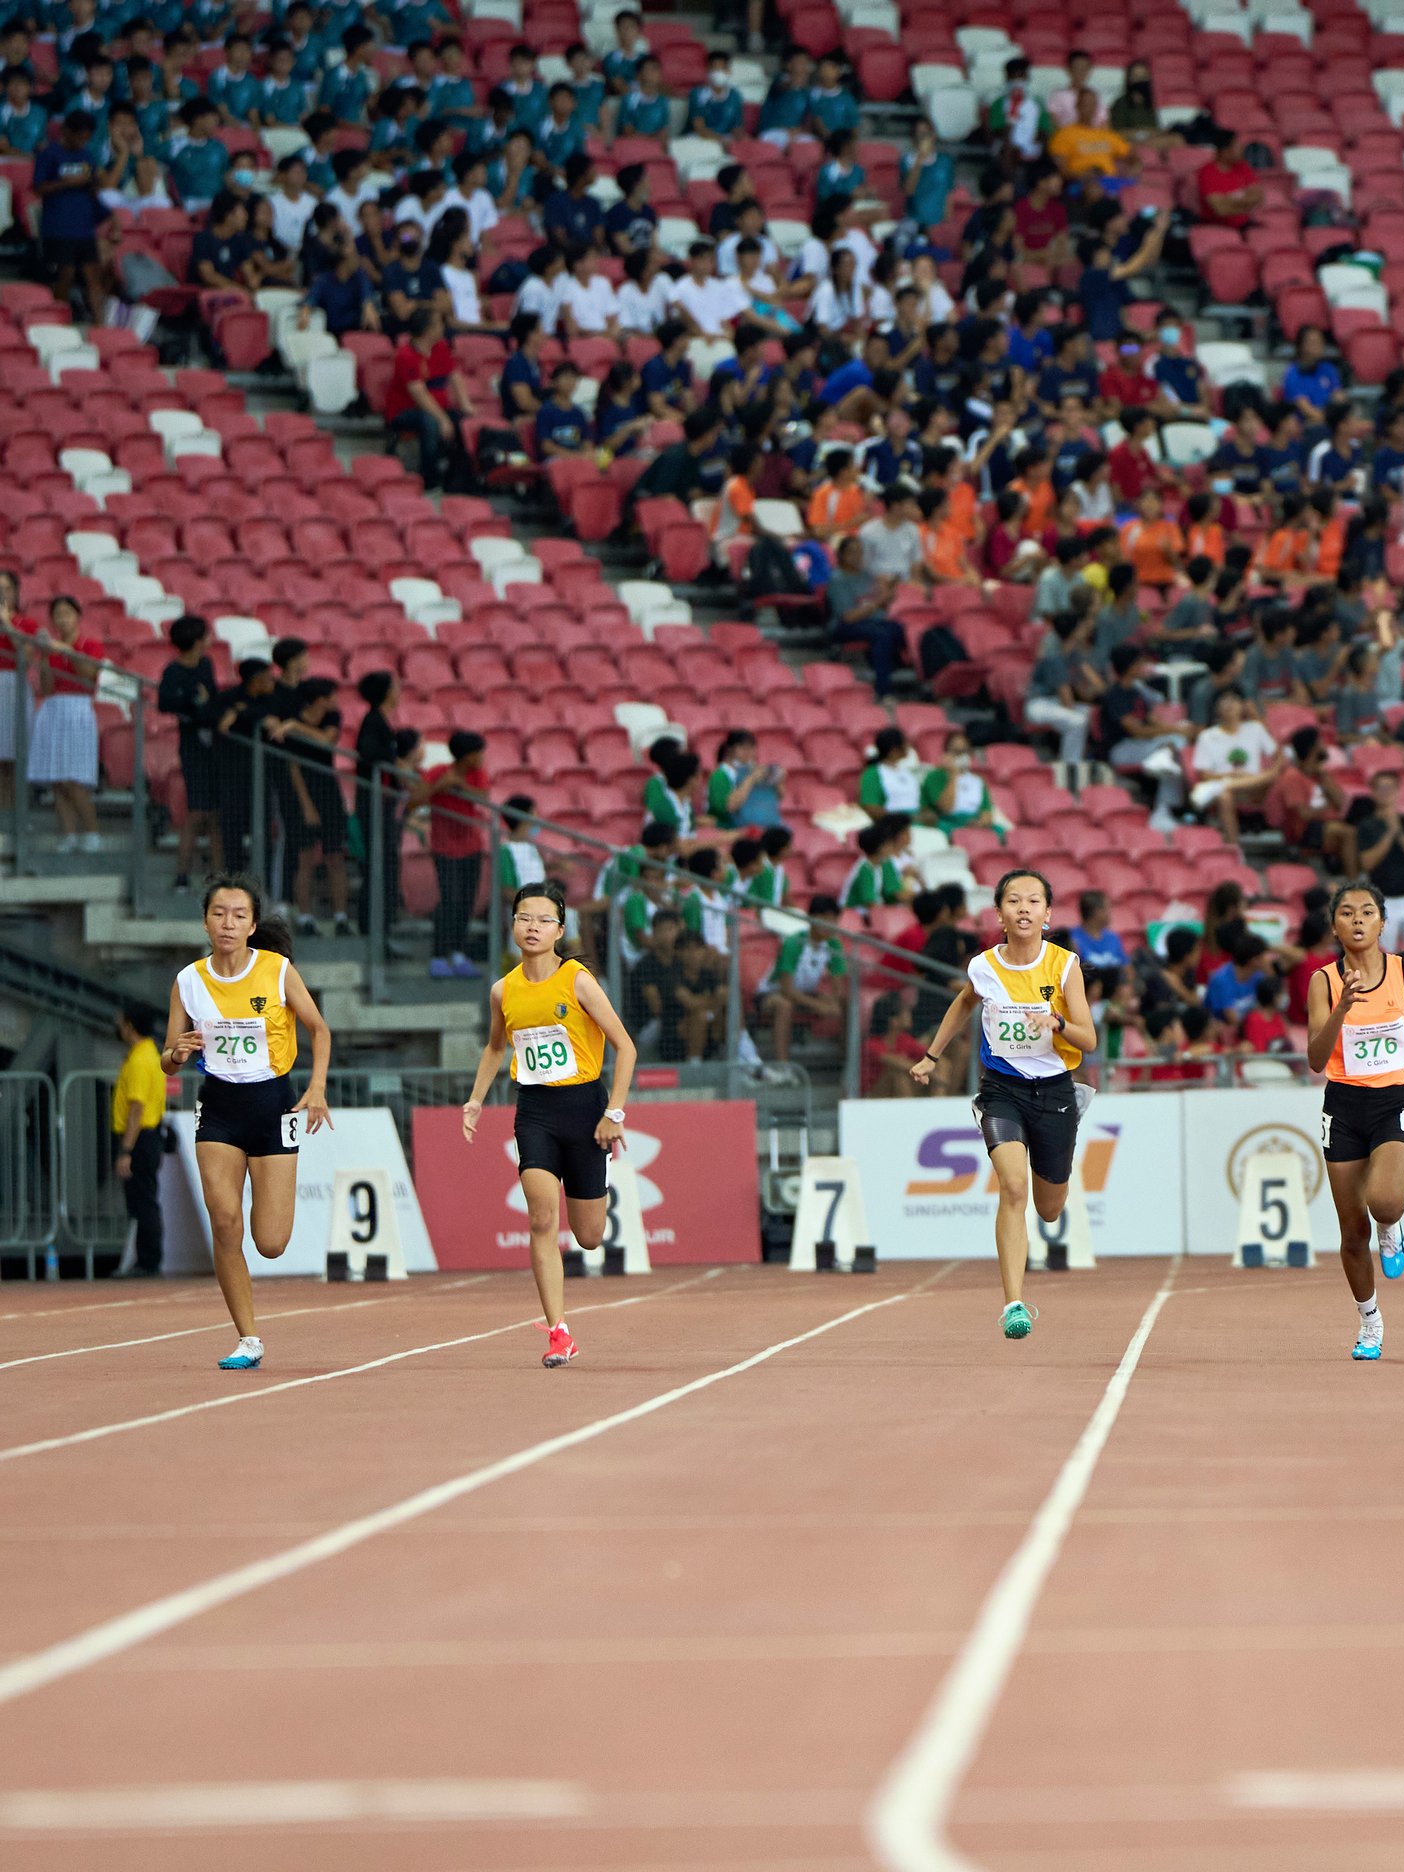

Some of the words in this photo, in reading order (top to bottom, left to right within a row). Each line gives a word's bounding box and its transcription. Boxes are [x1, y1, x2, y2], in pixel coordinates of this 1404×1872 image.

[998, 1021, 1042, 1042] 283
[214, 1035, 258, 1056] 276
[525, 1041, 568, 1071] 059
[1354, 1037, 1398, 1060] 376
[289, 1117, 298, 1142] 8
[349, 1180, 378, 1243] 9
[815, 1180, 845, 1242] 7
[904, 1202, 990, 1217] SINGAPORE
[1259, 1178, 1289, 1240] 5
